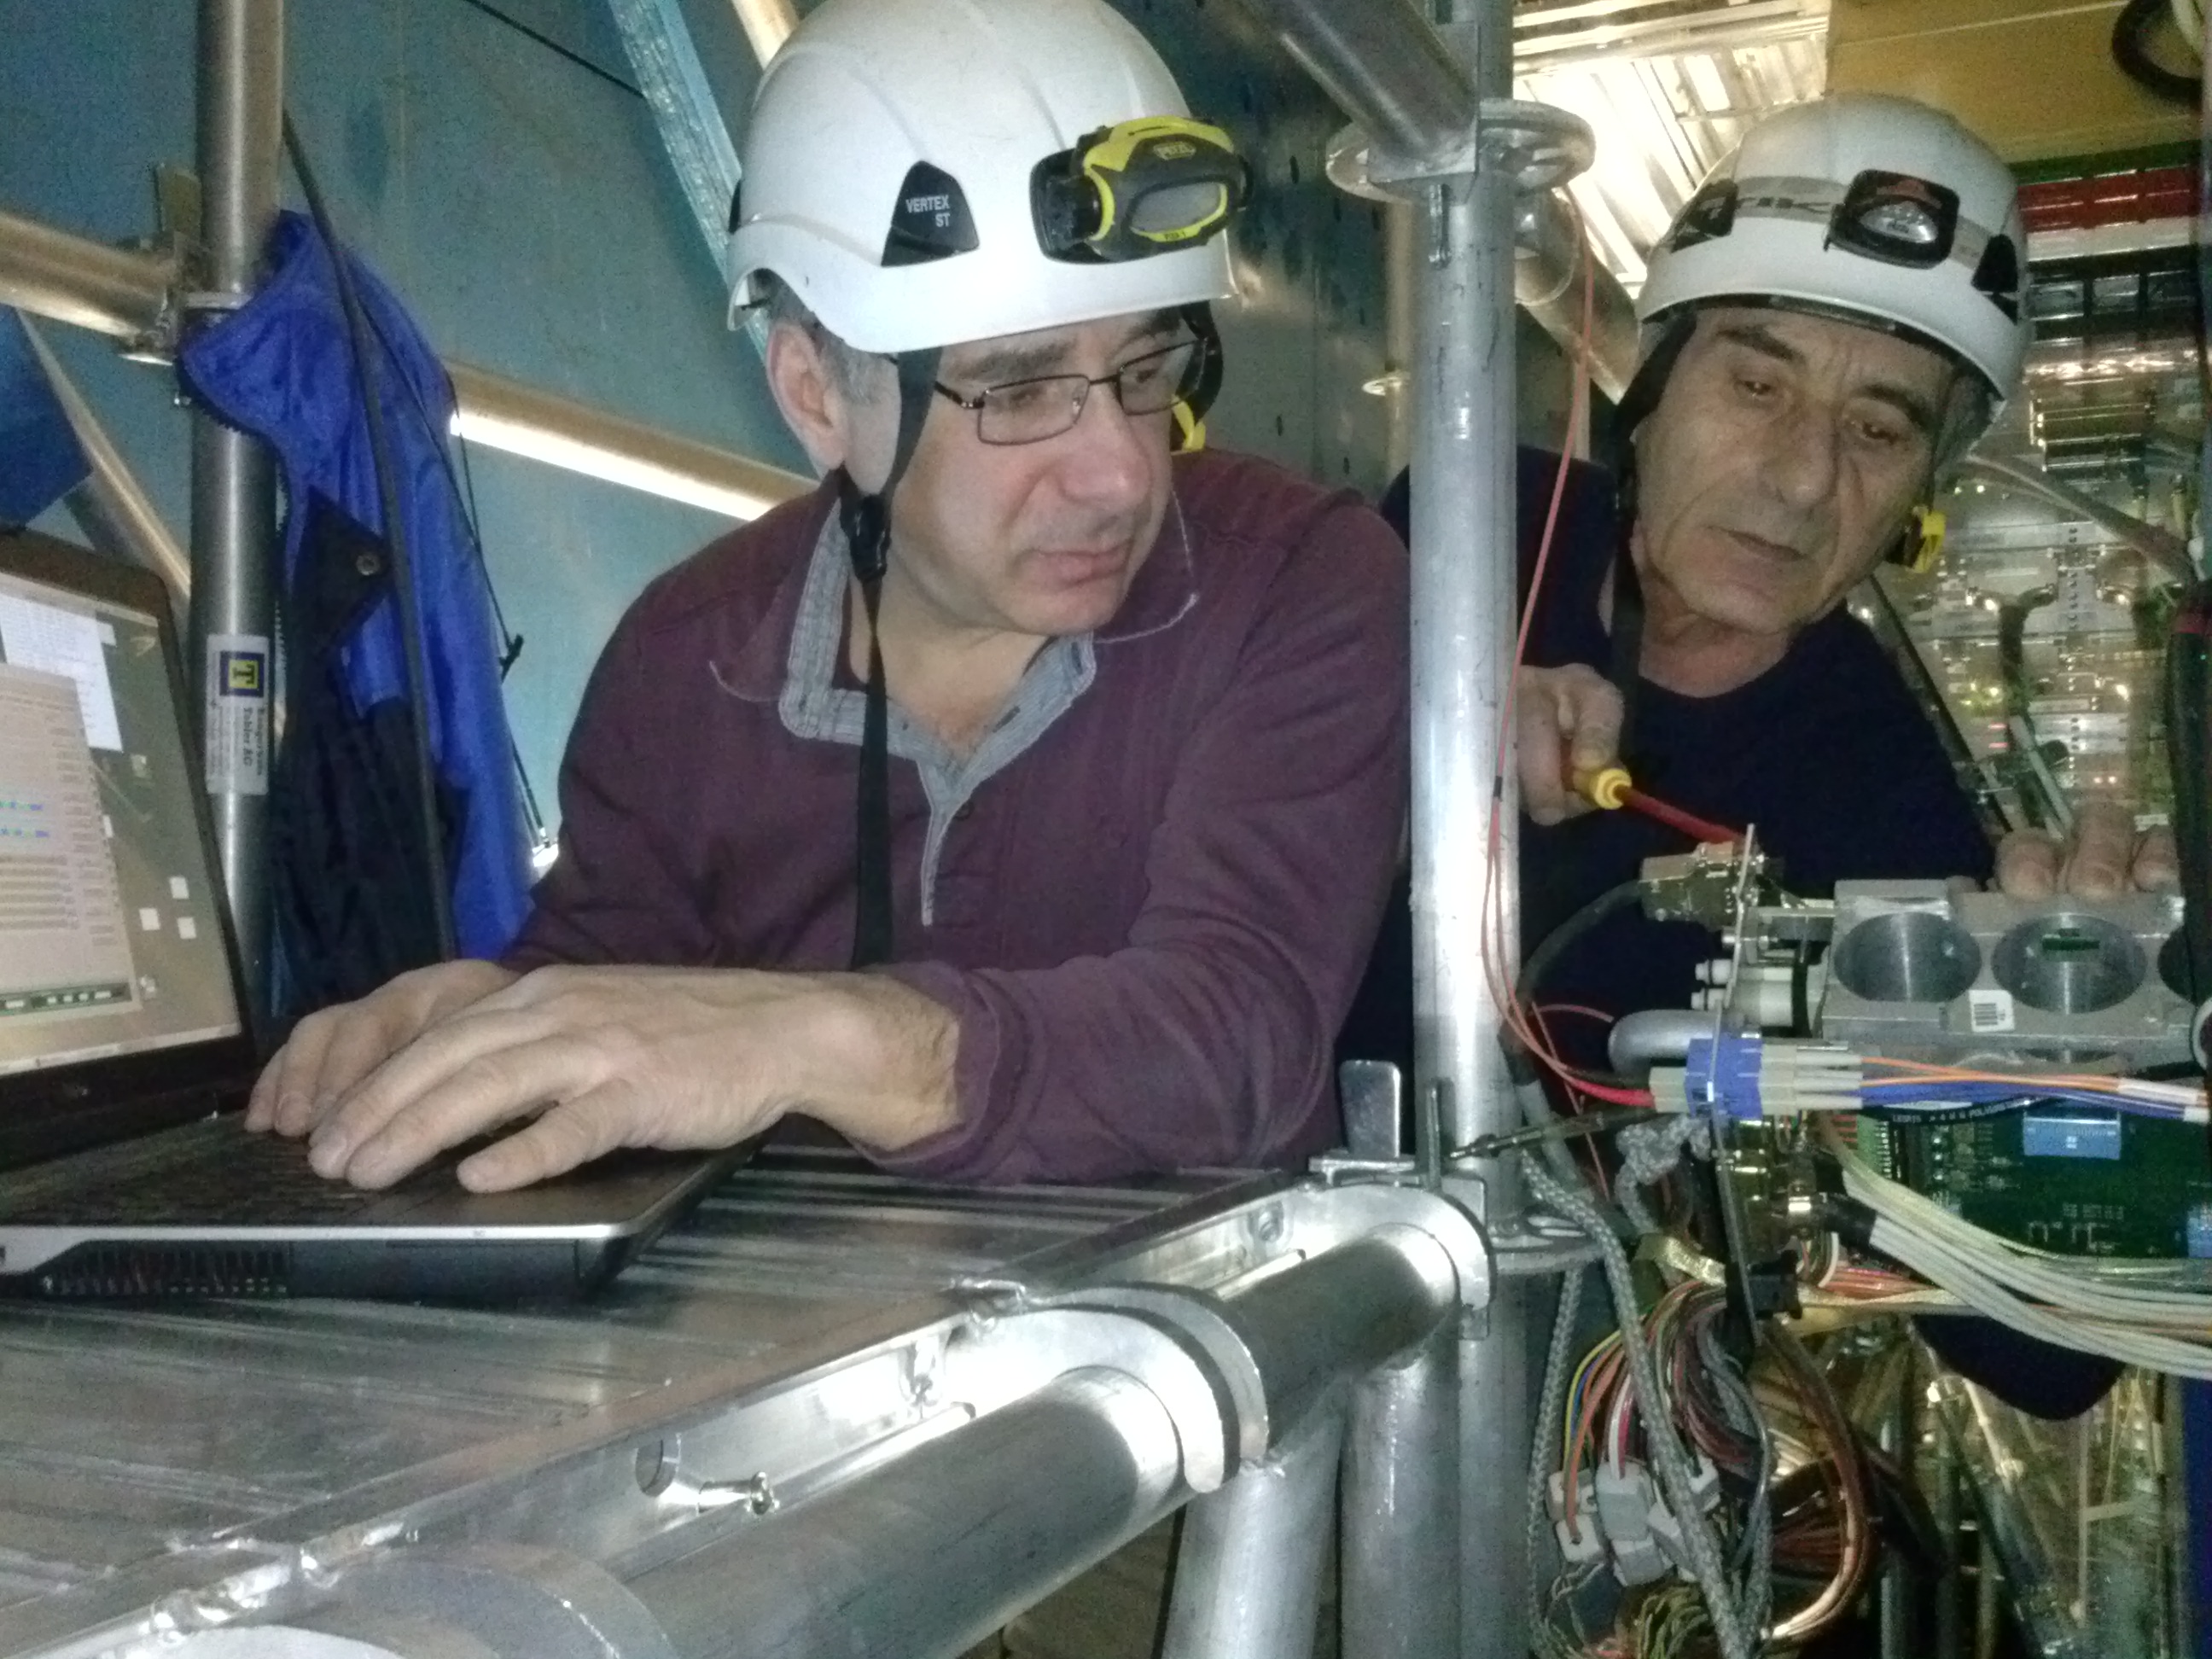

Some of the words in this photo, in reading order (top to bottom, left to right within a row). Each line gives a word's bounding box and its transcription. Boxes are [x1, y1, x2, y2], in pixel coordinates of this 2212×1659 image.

[905, 195, 950, 212] VERTEX
[935, 212, 950, 227] ST
[233, 664, 255, 684] T
[243, 707, 253, 745] Tobler
[243, 747, 253, 766] AG
